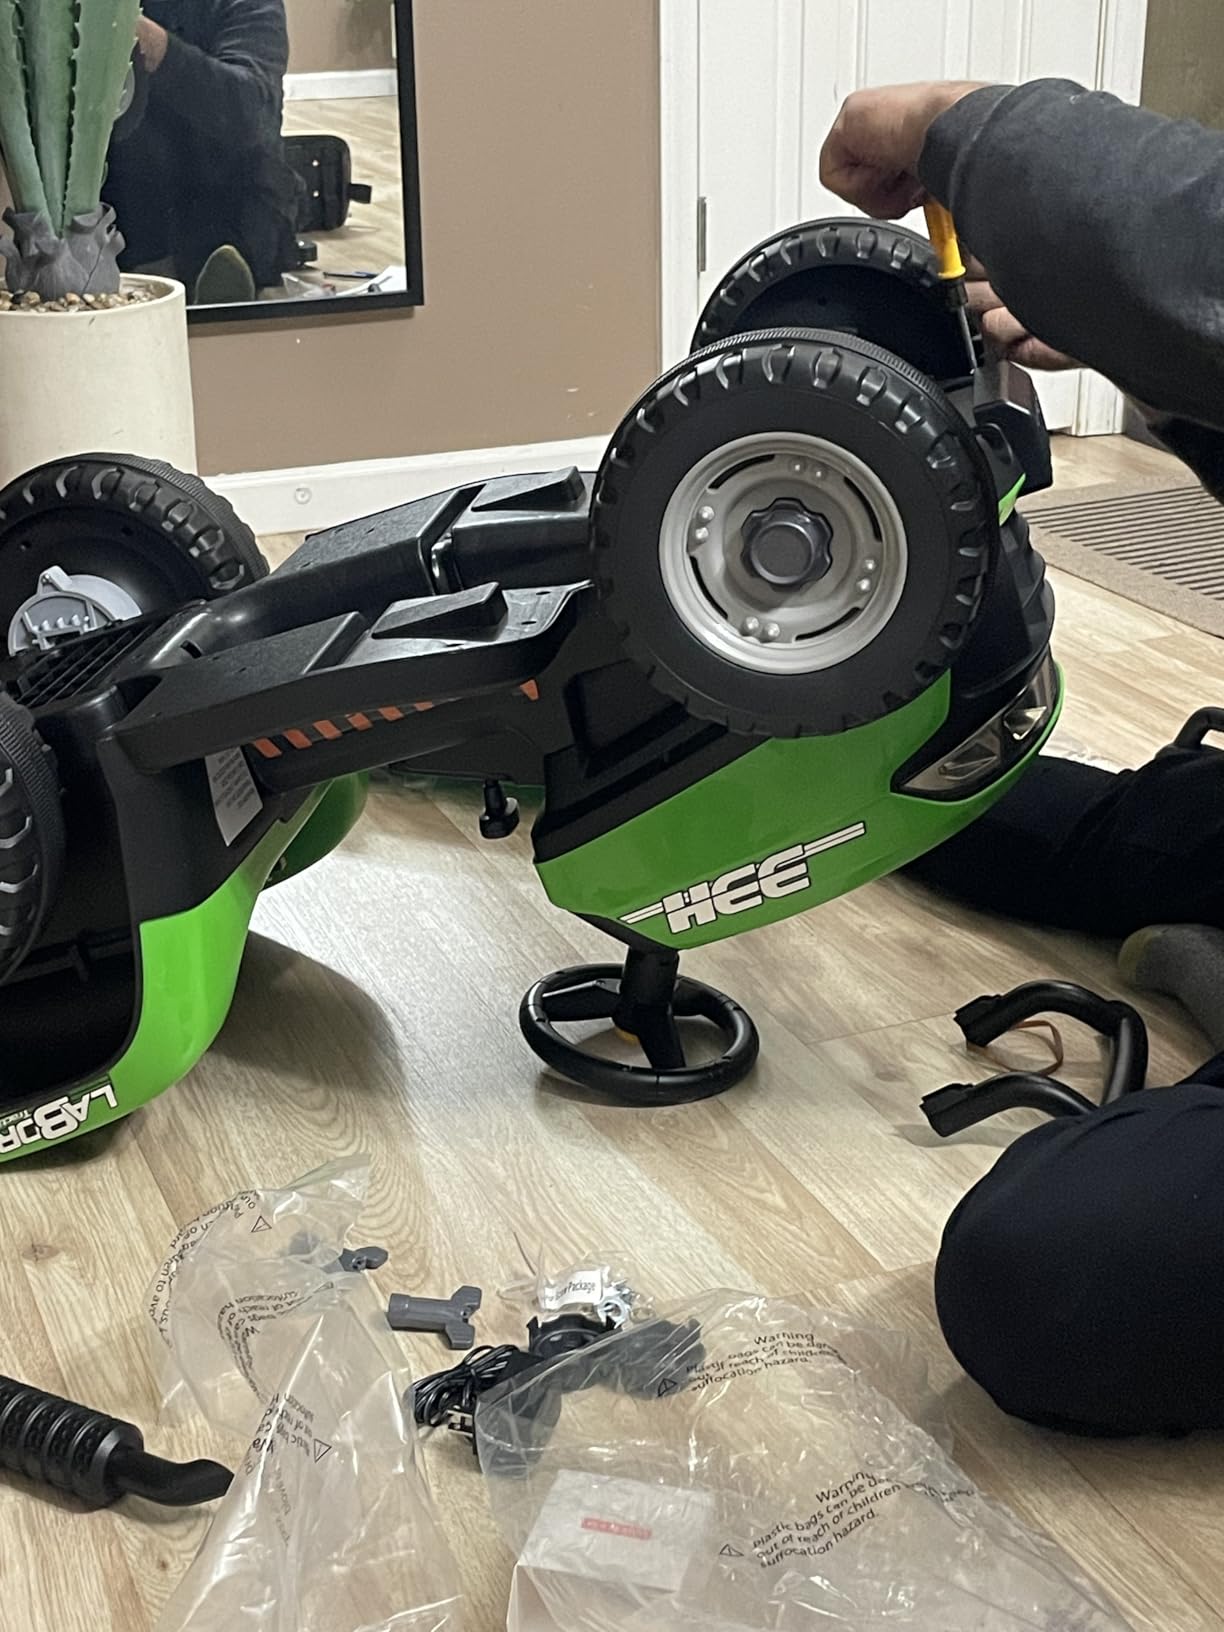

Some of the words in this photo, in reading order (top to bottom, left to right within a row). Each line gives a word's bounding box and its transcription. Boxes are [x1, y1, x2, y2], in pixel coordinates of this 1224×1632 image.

[754, 1332, 815, 1347] Warning
[816, 1472, 877, 1503] Warning
[847, 1483, 901, 1516] children
